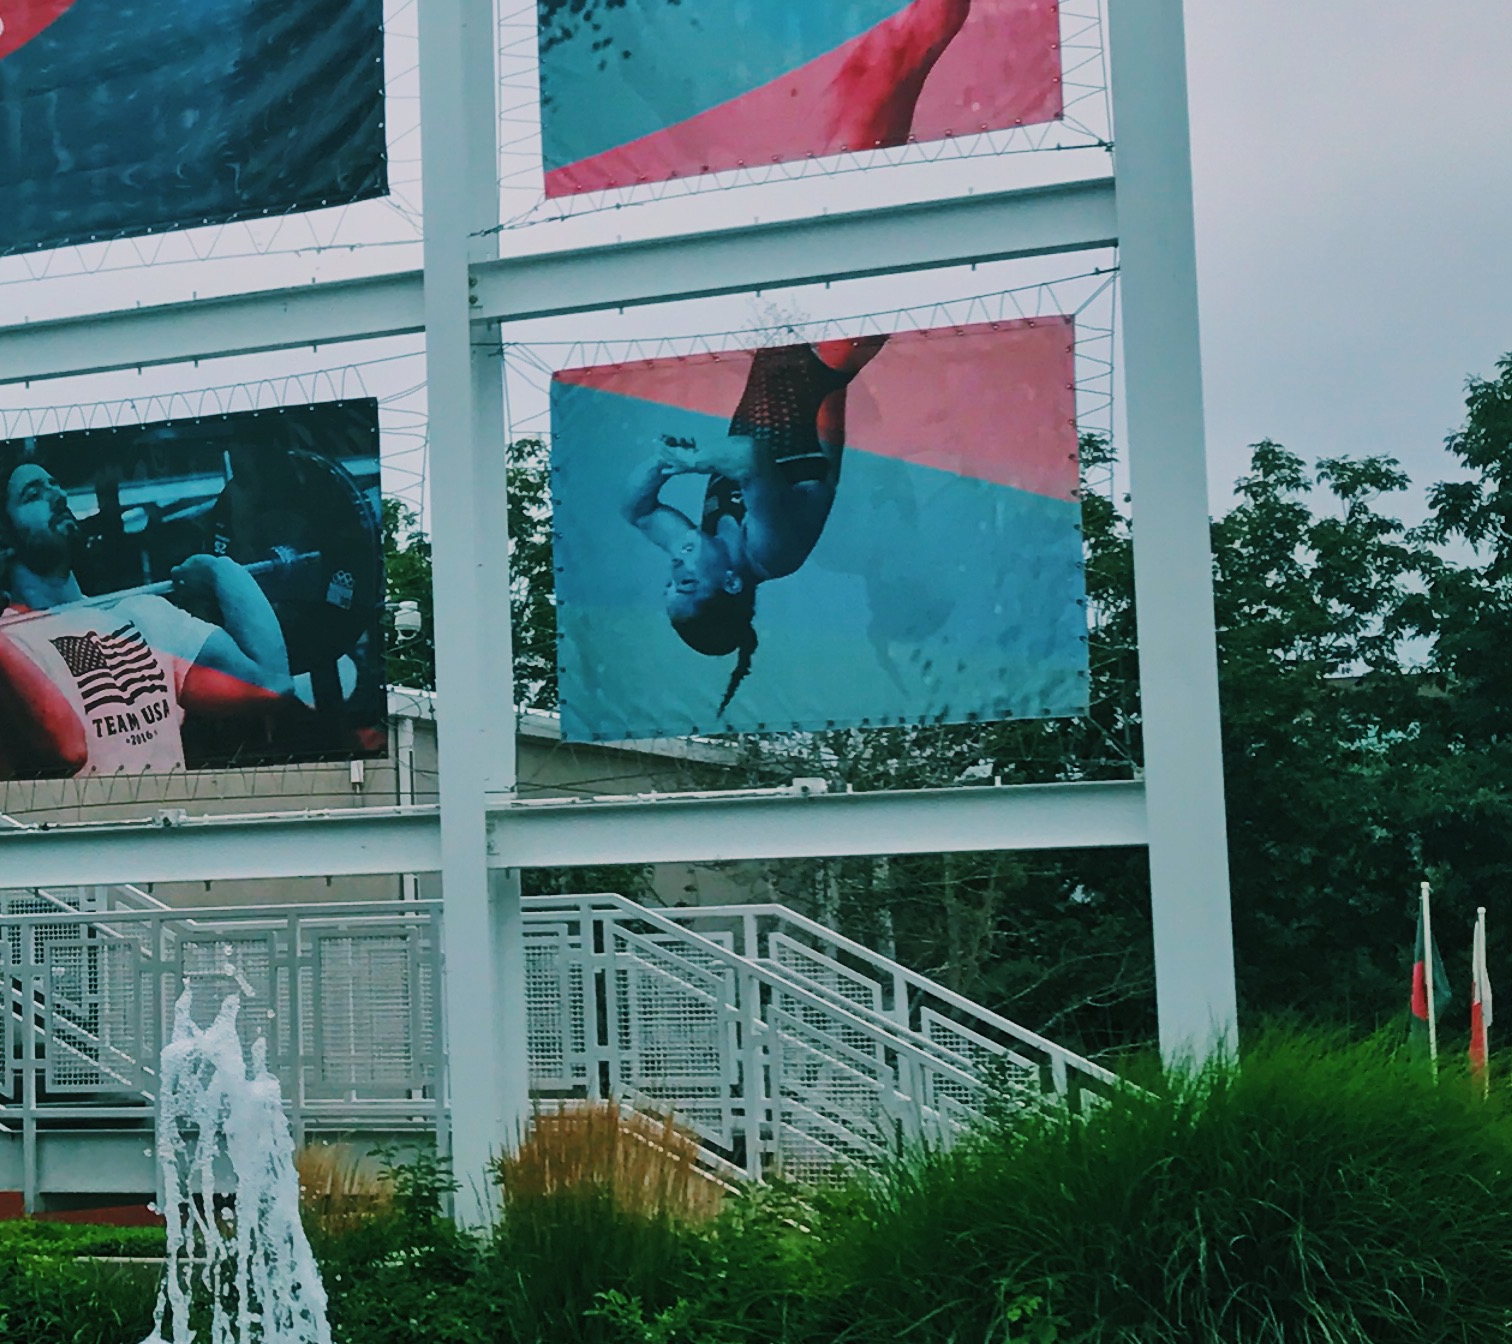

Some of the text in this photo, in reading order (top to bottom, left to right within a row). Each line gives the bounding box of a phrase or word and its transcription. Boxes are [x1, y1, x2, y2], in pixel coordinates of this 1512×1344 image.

[92, 699, 169, 738] TEAM USA
[130, 730, 153, 745] 2016
